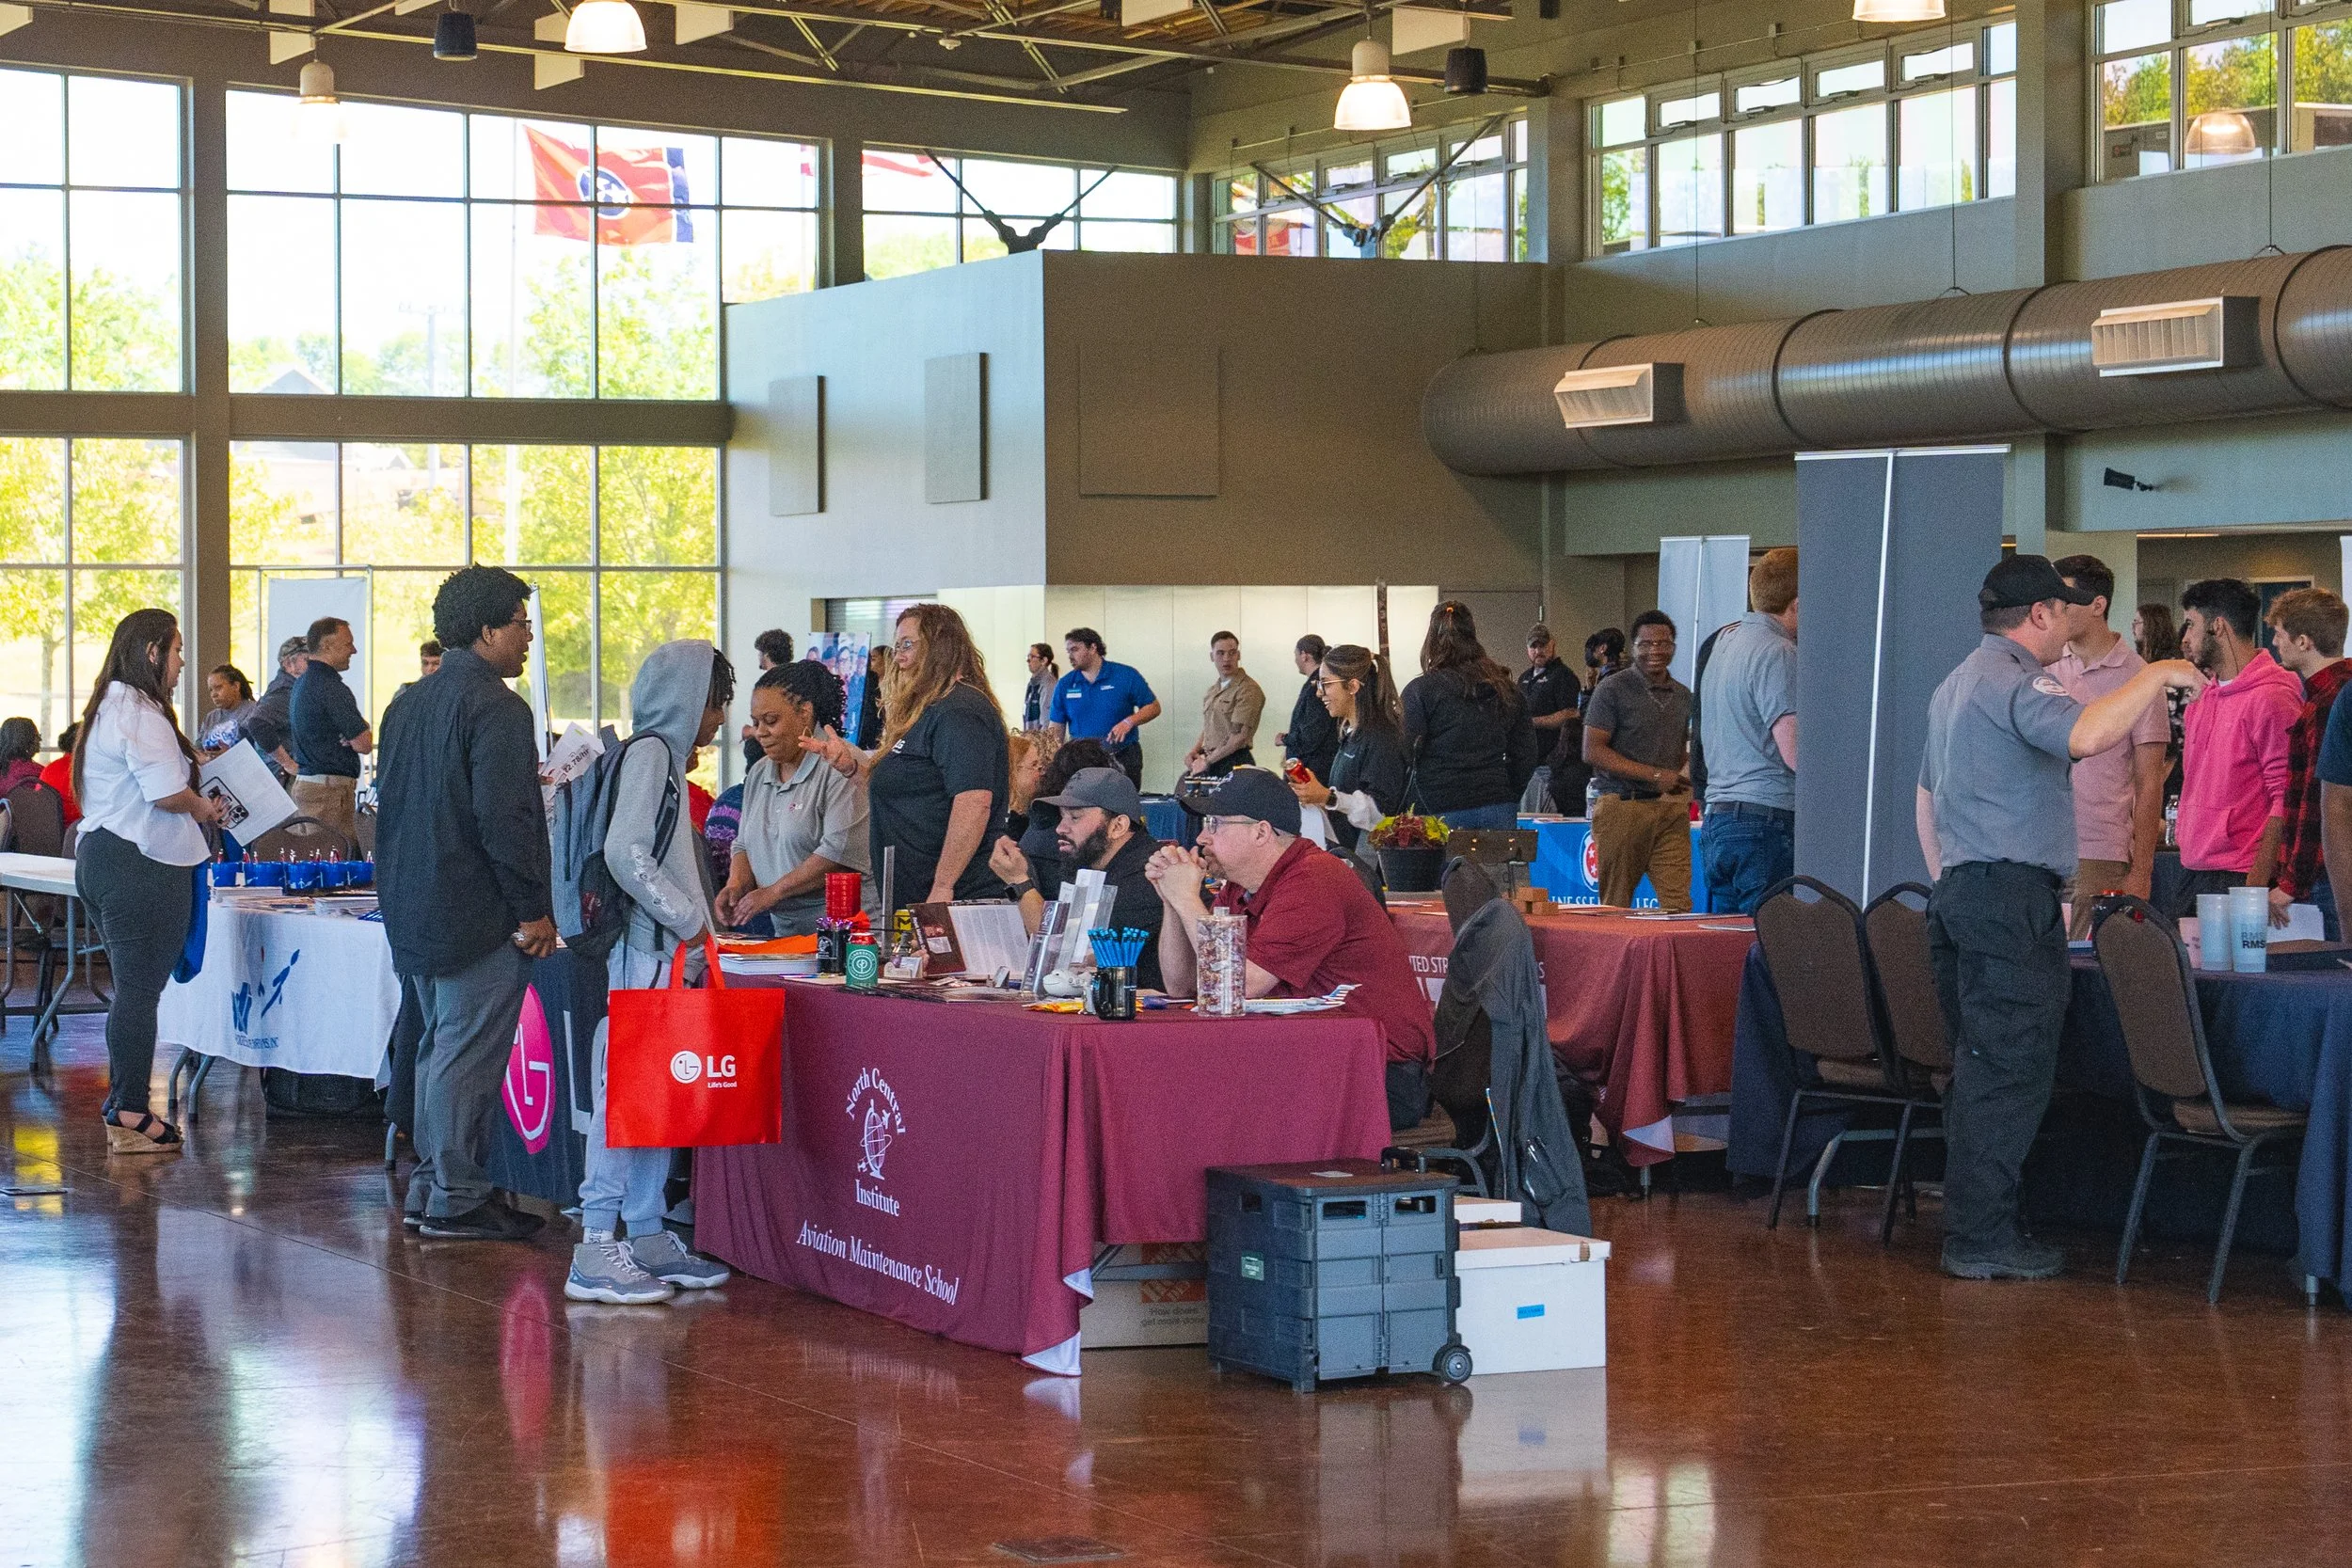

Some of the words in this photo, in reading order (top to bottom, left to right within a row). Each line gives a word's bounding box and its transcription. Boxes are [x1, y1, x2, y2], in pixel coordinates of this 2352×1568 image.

[2242, 940, 2266, 949] RMS
[707, 1054, 737, 1078] LG
[846, 1068, 871, 1121] North
[871, 1068, 906, 1134] Central
[855, 1179, 900, 1217] Institute
[796, 1219, 847, 1259] Aviation
[849, 1235, 923, 1289] Maintenance
[924, 1264, 960, 1306] School
